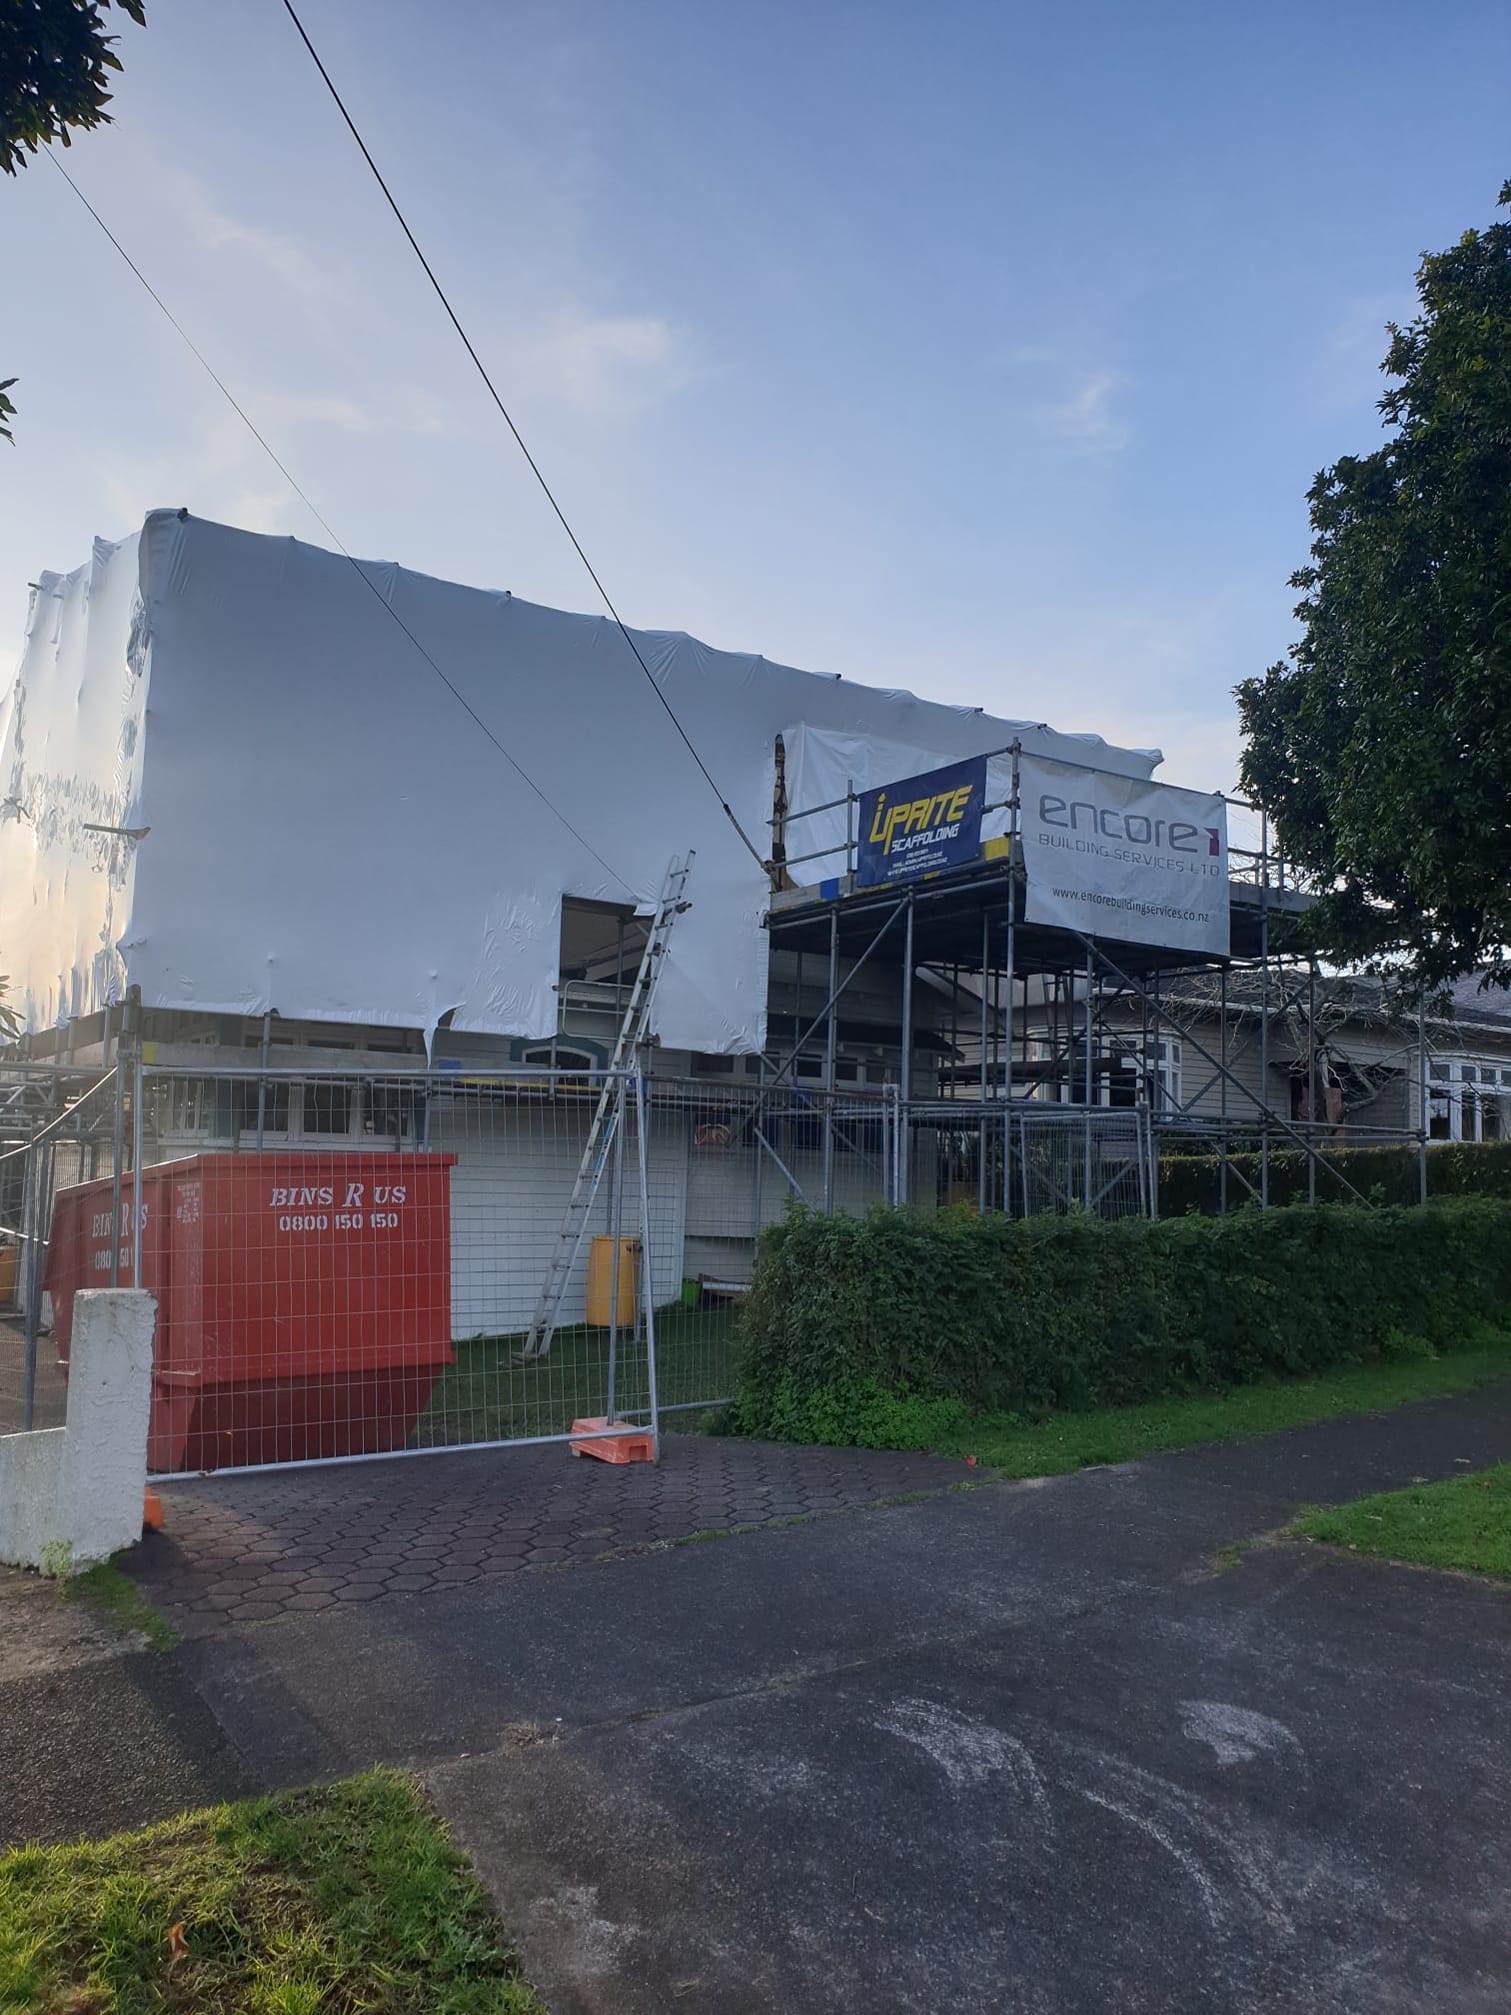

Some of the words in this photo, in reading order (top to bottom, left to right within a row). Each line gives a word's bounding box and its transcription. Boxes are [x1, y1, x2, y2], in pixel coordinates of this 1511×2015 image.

[891, 823, 960, 853] SCAFFOLDING
[1039, 833, 1109, 858] BUILDING
[1112, 849, 1184, 873] SERVICES
[1190, 863, 1220, 877] LTD
[1051, 887, 1209, 923] www.encorebuildingservices.co.nz
[269, 1186, 334, 1207] BINS
[341, 1182, 365, 1207] R
[374, 1185, 407, 1204] US
[92, 1211, 116, 1238] BIN
[121, 1202, 130, 1237] R
[279, 1215, 328, 1232] 0800
[335, 1213, 363, 1230] 150
[370, 1212, 399, 1229] 150
